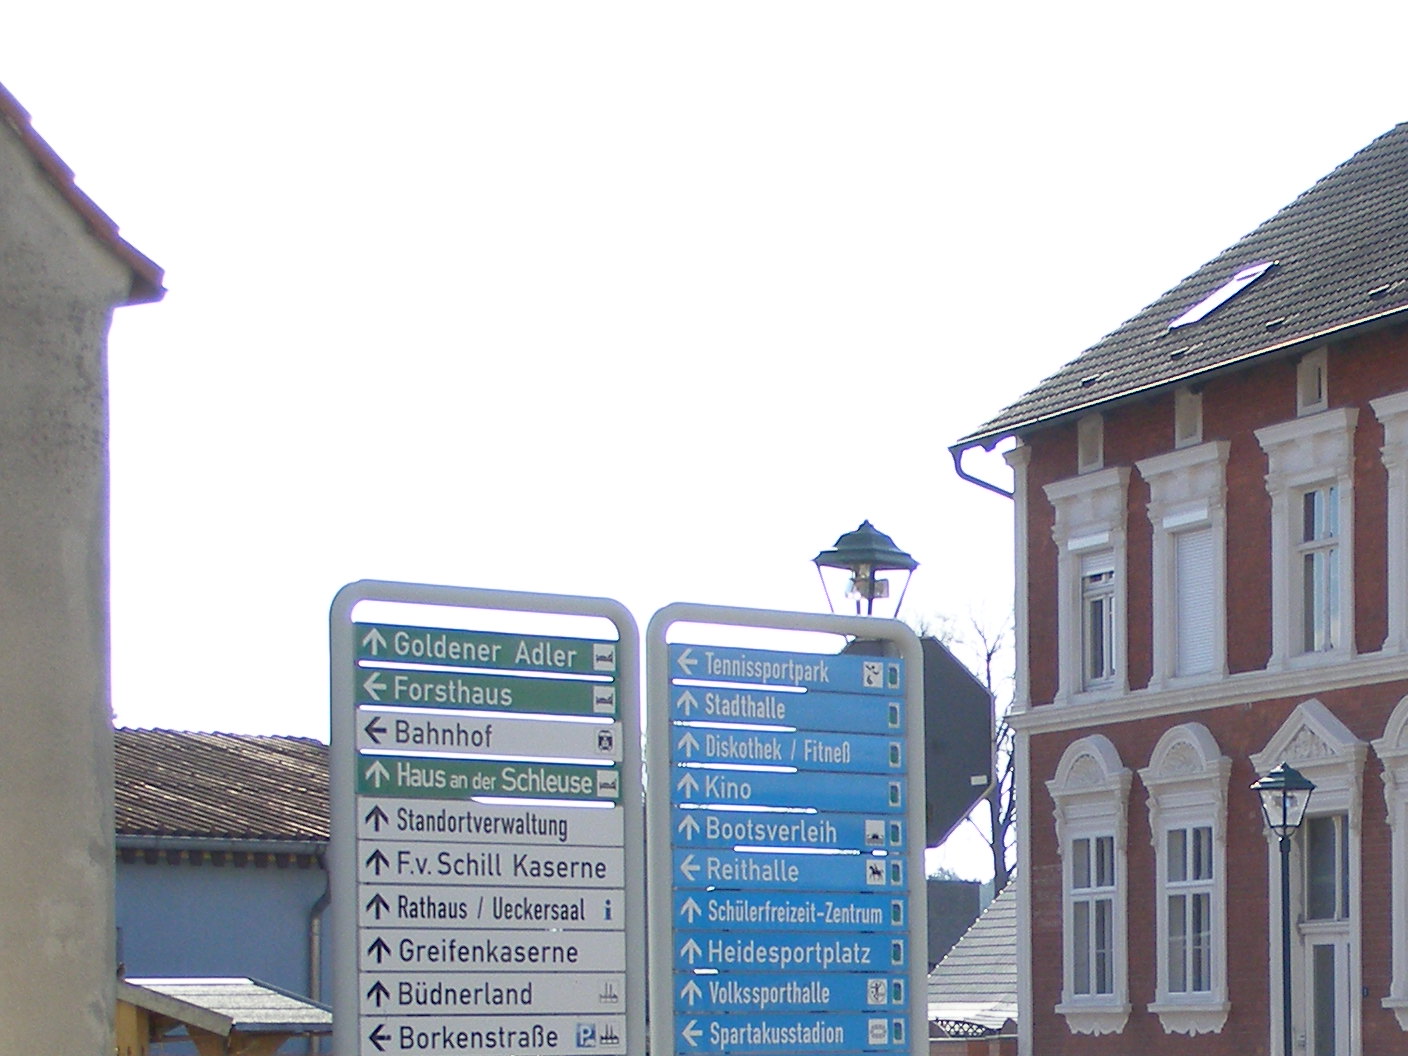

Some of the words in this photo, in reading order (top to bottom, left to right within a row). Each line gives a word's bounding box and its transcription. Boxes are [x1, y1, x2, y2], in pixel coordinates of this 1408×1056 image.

[394, 631, 501, 662] Goldener
[514, 641, 578, 668] Adler
[706, 652, 829, 685] Tennissportpark
[394, 676, 512, 706] Forsthaus
[706, 693, 786, 719] Stadthalle
[396, 720, 492, 747] Bahnhof
[706, 735, 782, 760] Diskothek
[790, 739, 796, 759] /
[804, 740, 850, 763] Fitneß
[397, 762, 446, 788] Haus
[450, 774, 468, 788] an
[472, 772, 496, 790] der
[501, 768, 592, 794] Schleuse
[705, 776, 751, 800] Kino
[397, 807, 568, 841] Standortverwaltung
[707, 817, 837, 843] Bootsverleih
[438, 852, 501, 876] Schill
[514, 854, 606, 879] Kaserne
[707, 859, 799, 882] Reithalle
[398, 896, 467, 919] Rathaus
[477, 896, 484, 919] /
[493, 896, 585, 920] Ueckersaal
[708, 900, 882, 924] Schülerfreizeit-Zentrum
[400, 938, 578, 963] Greifenkaserne
[707, 940, 871, 968] Heidesportplatz
[399, 982, 532, 1005] Büdnerland
[709, 981, 829, 1009] Volkssporthalle
[400, 1023, 558, 1049] Borkenstraße
[710, 1021, 843, 1050] Spartakusstadion
